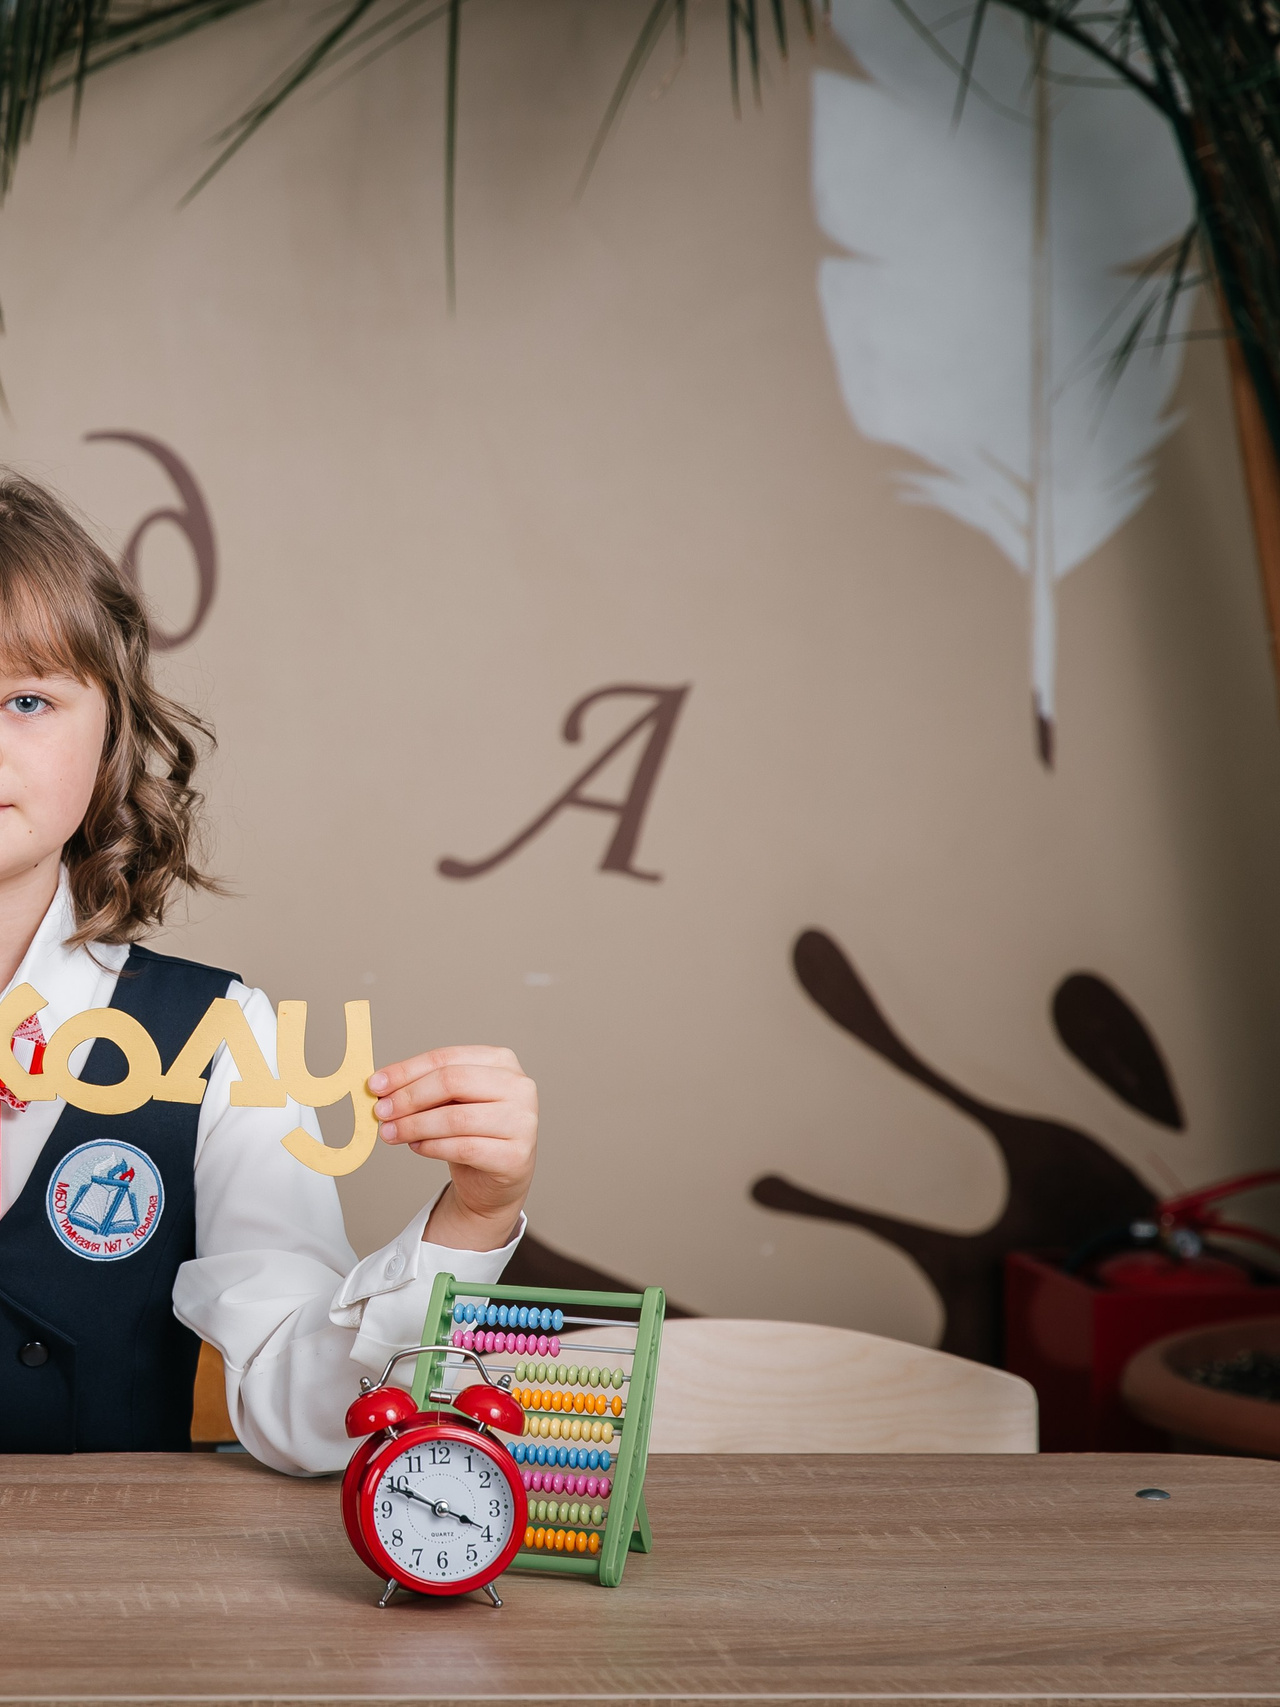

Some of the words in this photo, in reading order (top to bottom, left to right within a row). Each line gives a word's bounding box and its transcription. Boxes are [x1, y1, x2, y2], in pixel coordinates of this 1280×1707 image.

[54, 1181, 70, 1216] МБОУ
[132, 1195, 158, 1240] Крымска
[405, 1455, 425, 1474] 11
[428, 1446, 451, 1465] 12
[464, 1455, 476, 1473] 1
[386, 1475, 409, 1494] 10
[479, 1470, 491, 1489] 2
[381, 1500, 393, 1519] 9
[489, 1499, 501, 1518] 3
[391, 1528, 404, 1547] 8
[480, 1525, 494, 1543] 4
[411, 1548, 424, 1566] 7
[437, 1551, 449, 1569] 6
[466, 1543, 478, 1562] 5
